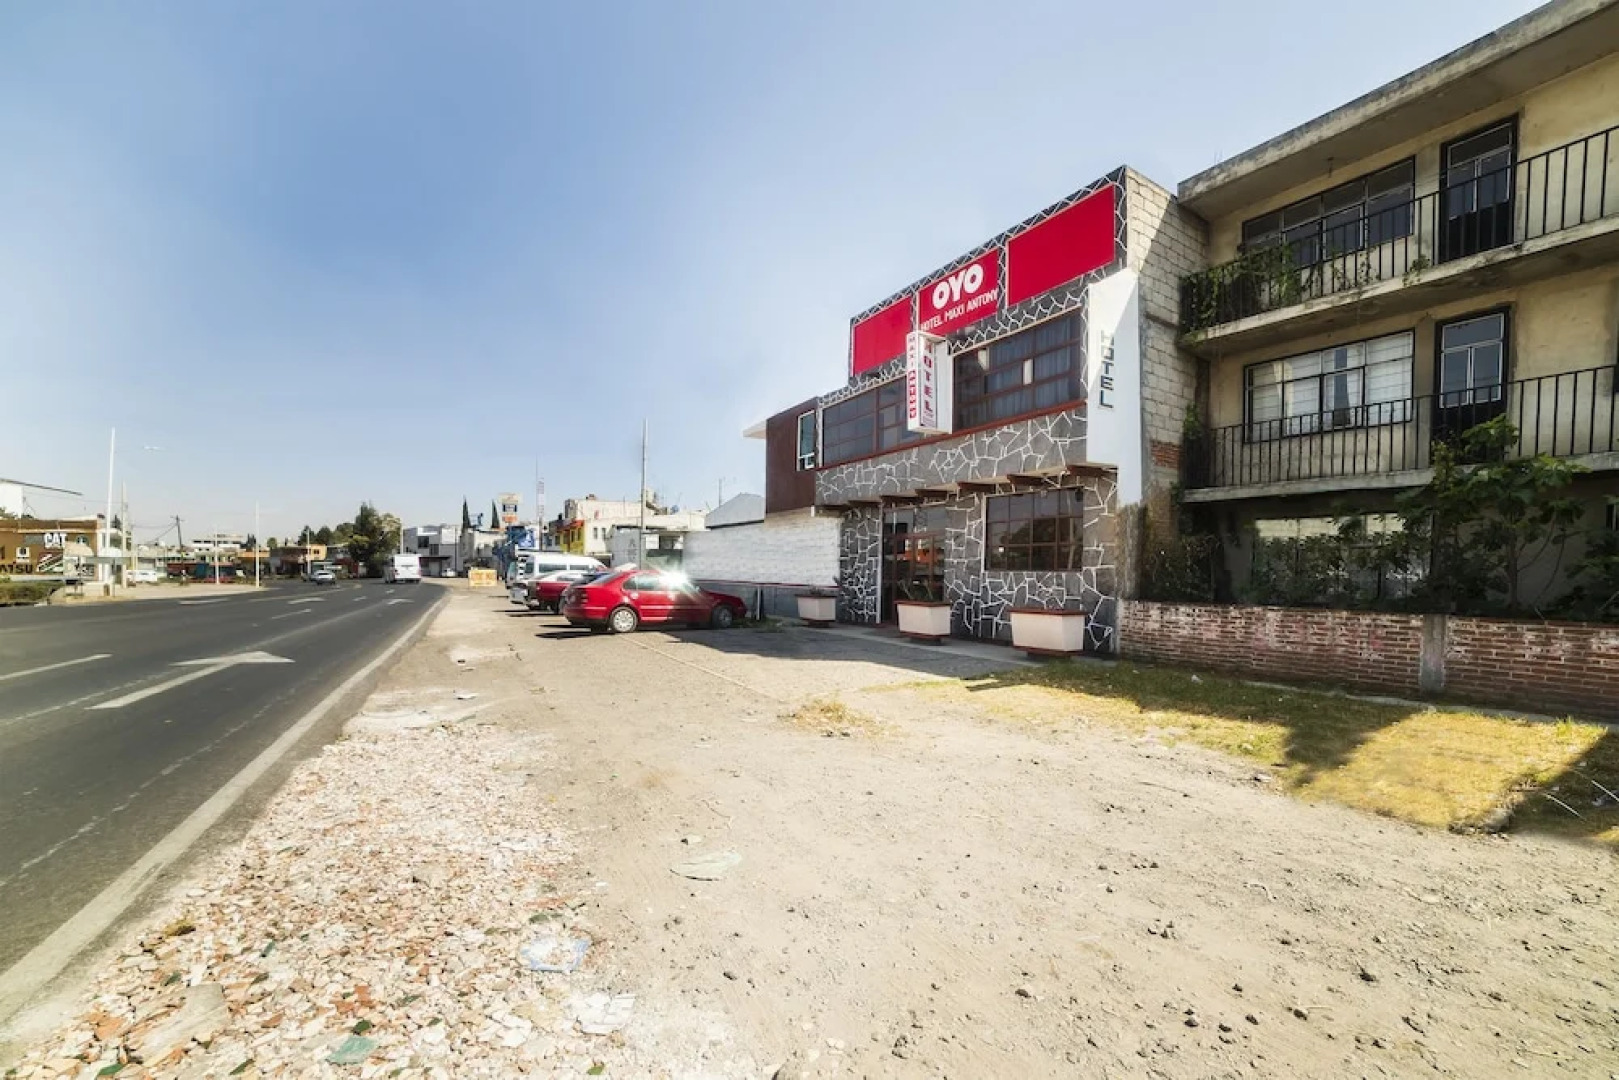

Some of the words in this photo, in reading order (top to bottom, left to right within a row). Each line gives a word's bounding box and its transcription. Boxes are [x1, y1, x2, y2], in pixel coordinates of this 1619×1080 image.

[932, 264, 984, 309] OYO
[920, 313, 943, 332] HOTEL
[944, 303, 965, 322] MAXI
[966, 288, 998, 313] ANTONY
[923, 339, 933, 414] HOTEL
[1100, 329, 1115, 409] HOTEL
[44, 532, 67, 548] CAT
